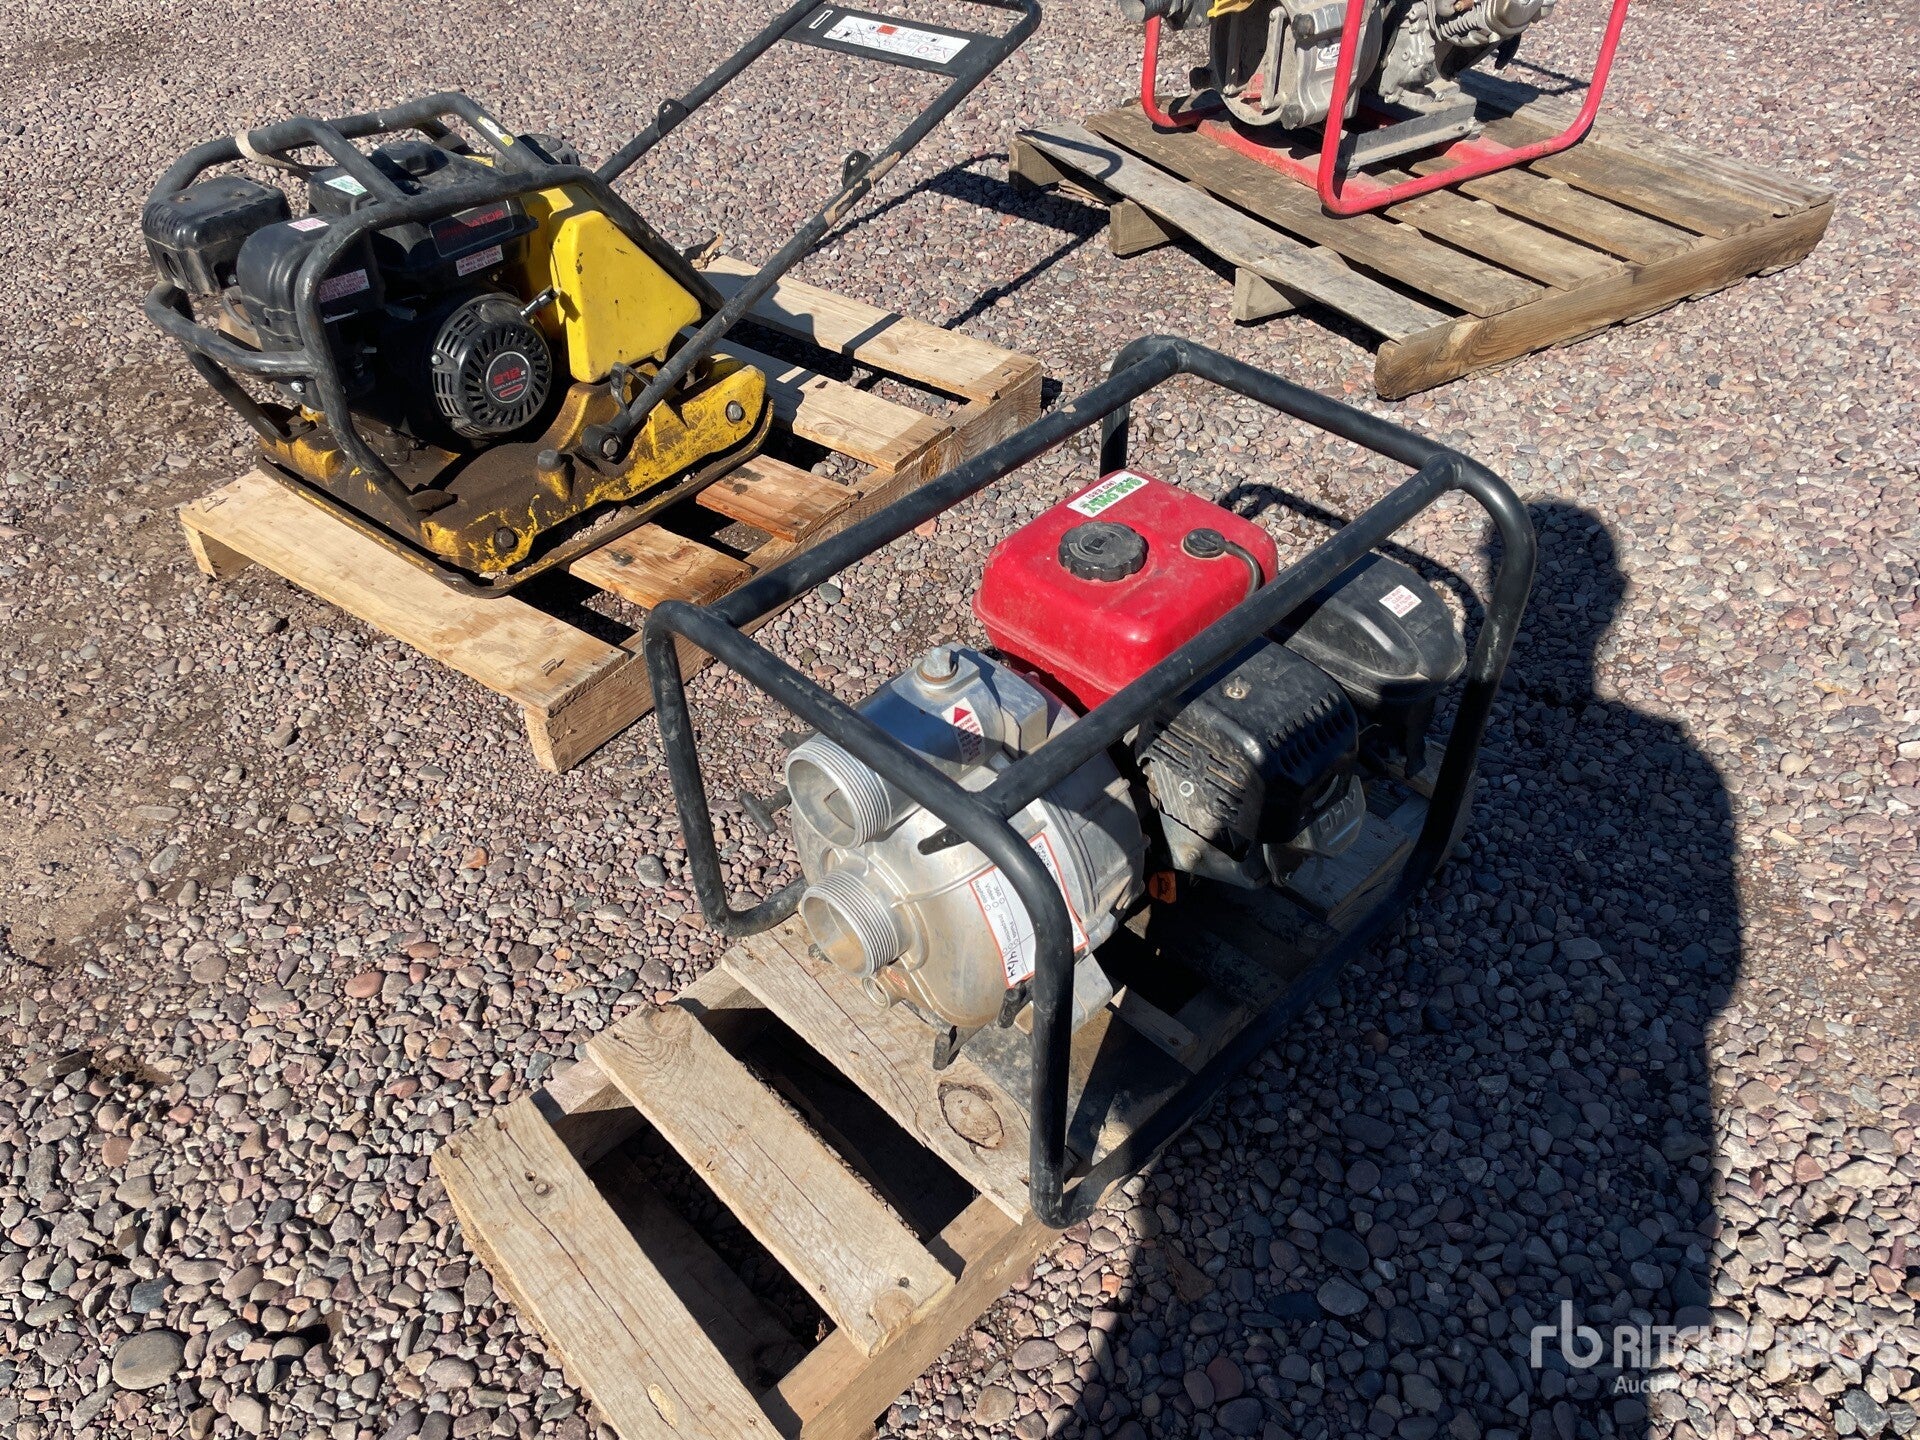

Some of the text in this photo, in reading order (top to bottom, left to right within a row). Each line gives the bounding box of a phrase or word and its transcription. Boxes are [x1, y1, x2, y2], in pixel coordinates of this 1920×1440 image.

[1087, 493, 1119, 513] ONLY
[986, 882, 995, 899] Video
[998, 913, 1012, 942] Inspection
